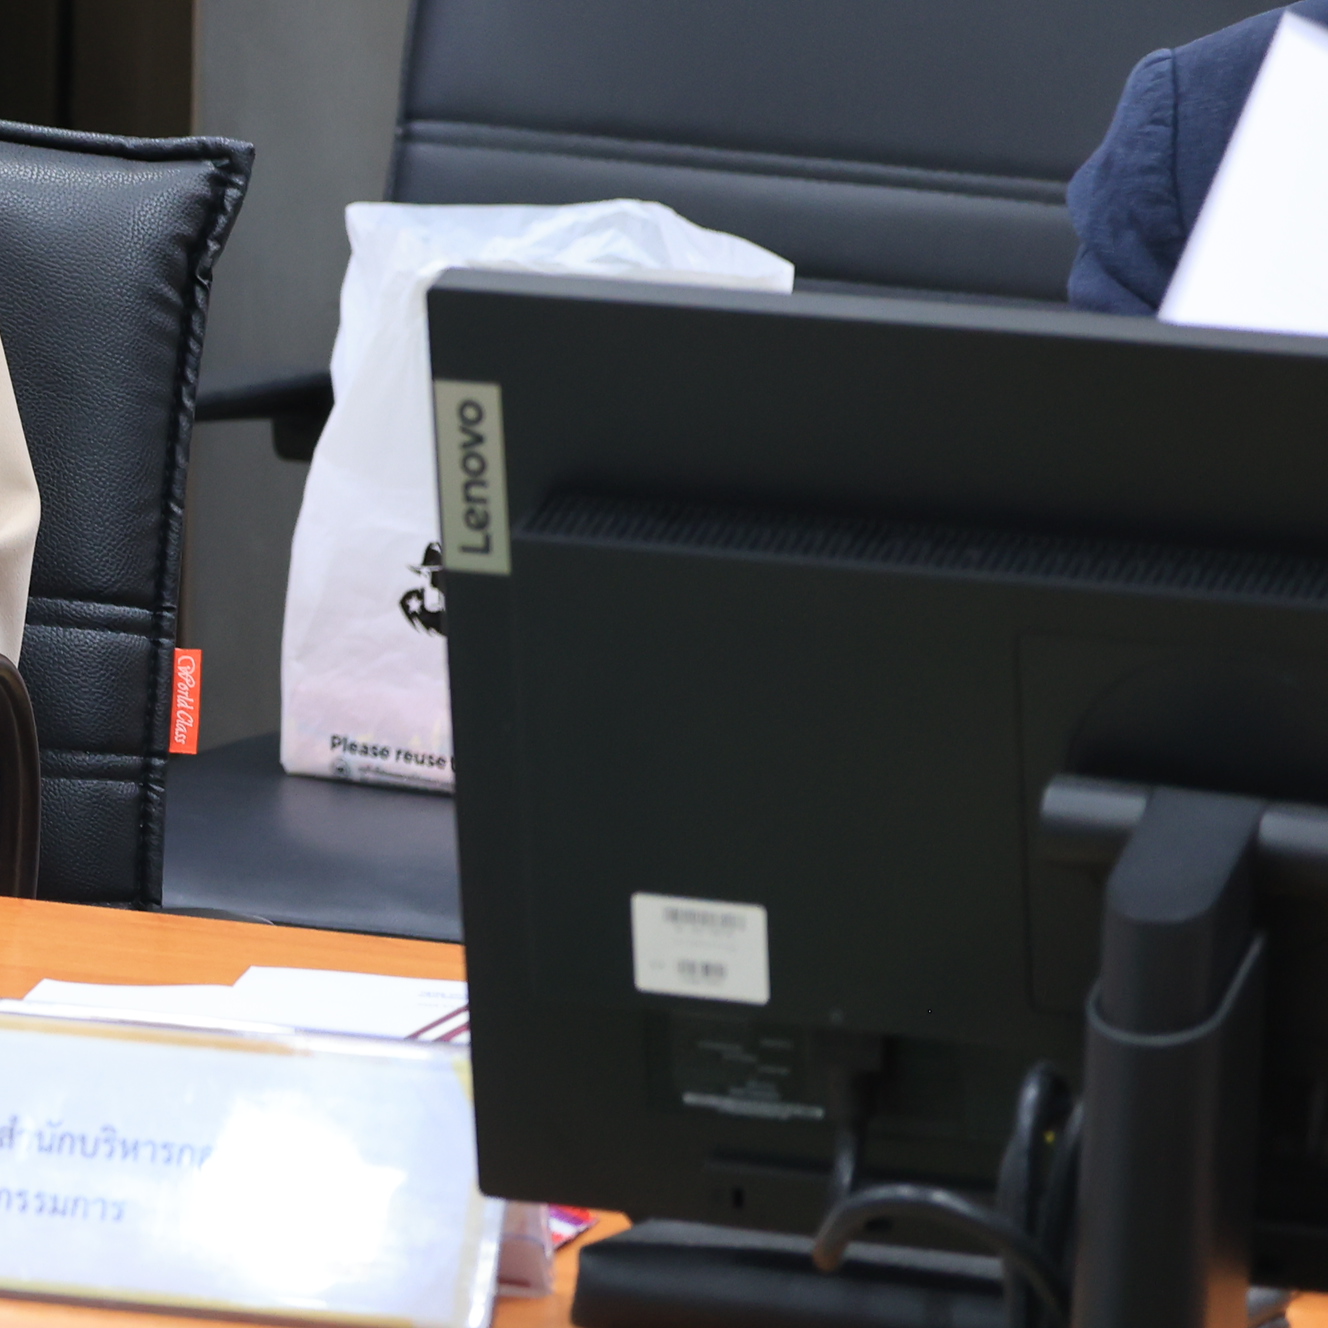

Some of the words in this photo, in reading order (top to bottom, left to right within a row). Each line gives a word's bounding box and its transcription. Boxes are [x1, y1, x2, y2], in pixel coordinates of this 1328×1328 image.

[459, 399, 492, 556] Lenovo
[176, 655, 196, 709] World
[174, 708, 194, 745] Class
[330, 734, 390, 760] Please
[394, 748, 447, 770] reuse
